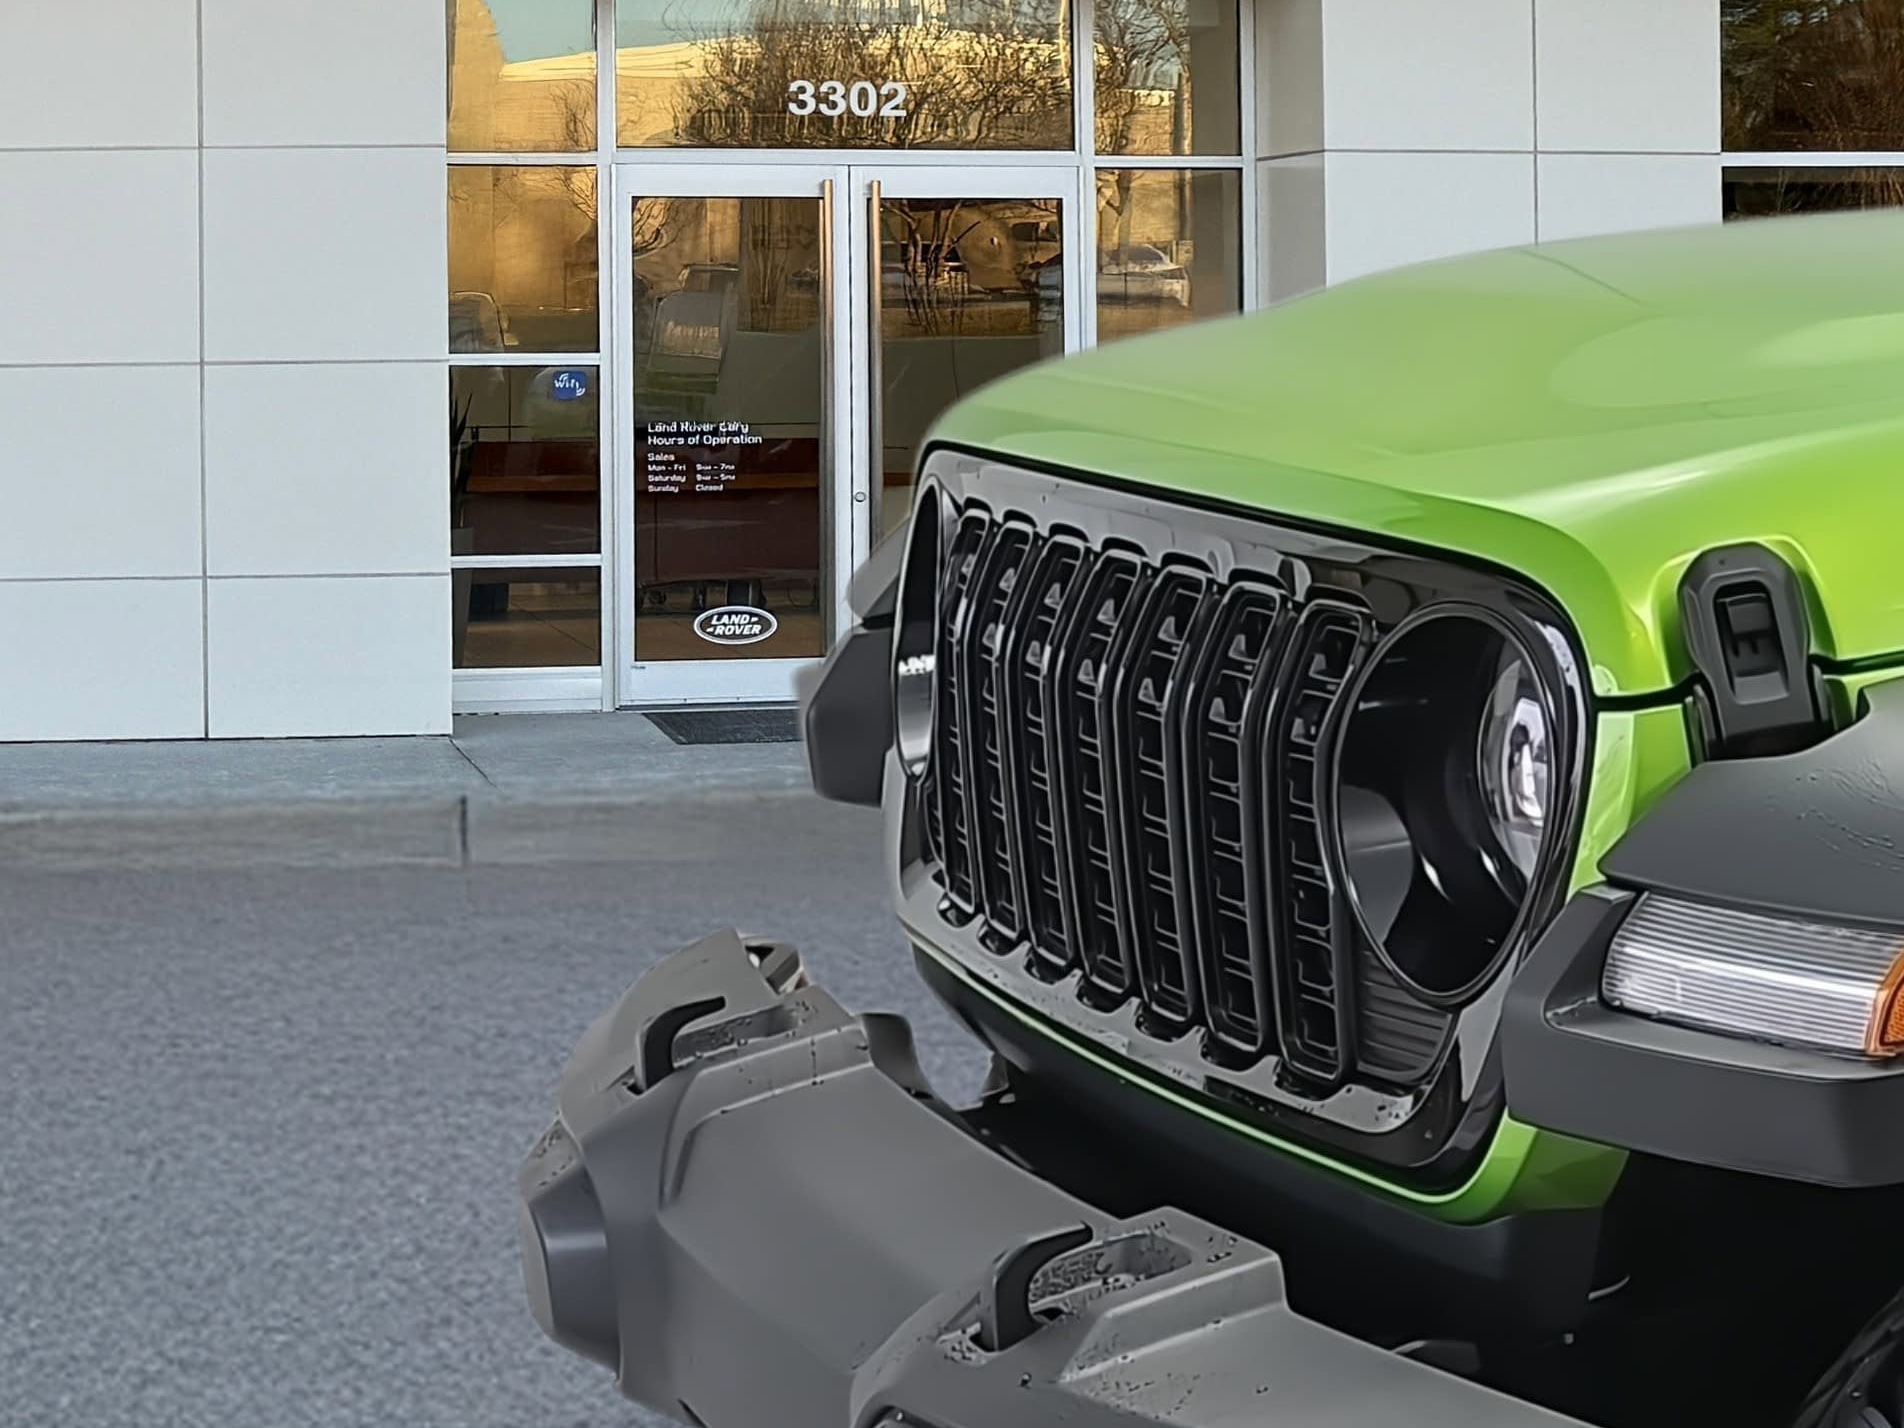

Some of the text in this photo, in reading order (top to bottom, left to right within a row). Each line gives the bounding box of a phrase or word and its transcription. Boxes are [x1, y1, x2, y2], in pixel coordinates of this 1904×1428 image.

[788, 79, 907, 117] 3302
[647, 434, 763, 447] Hours of Operation
[647, 452, 675, 462] Sales
[711, 614, 750, 625] LAND
[714, 624, 762, 635] ROVER
